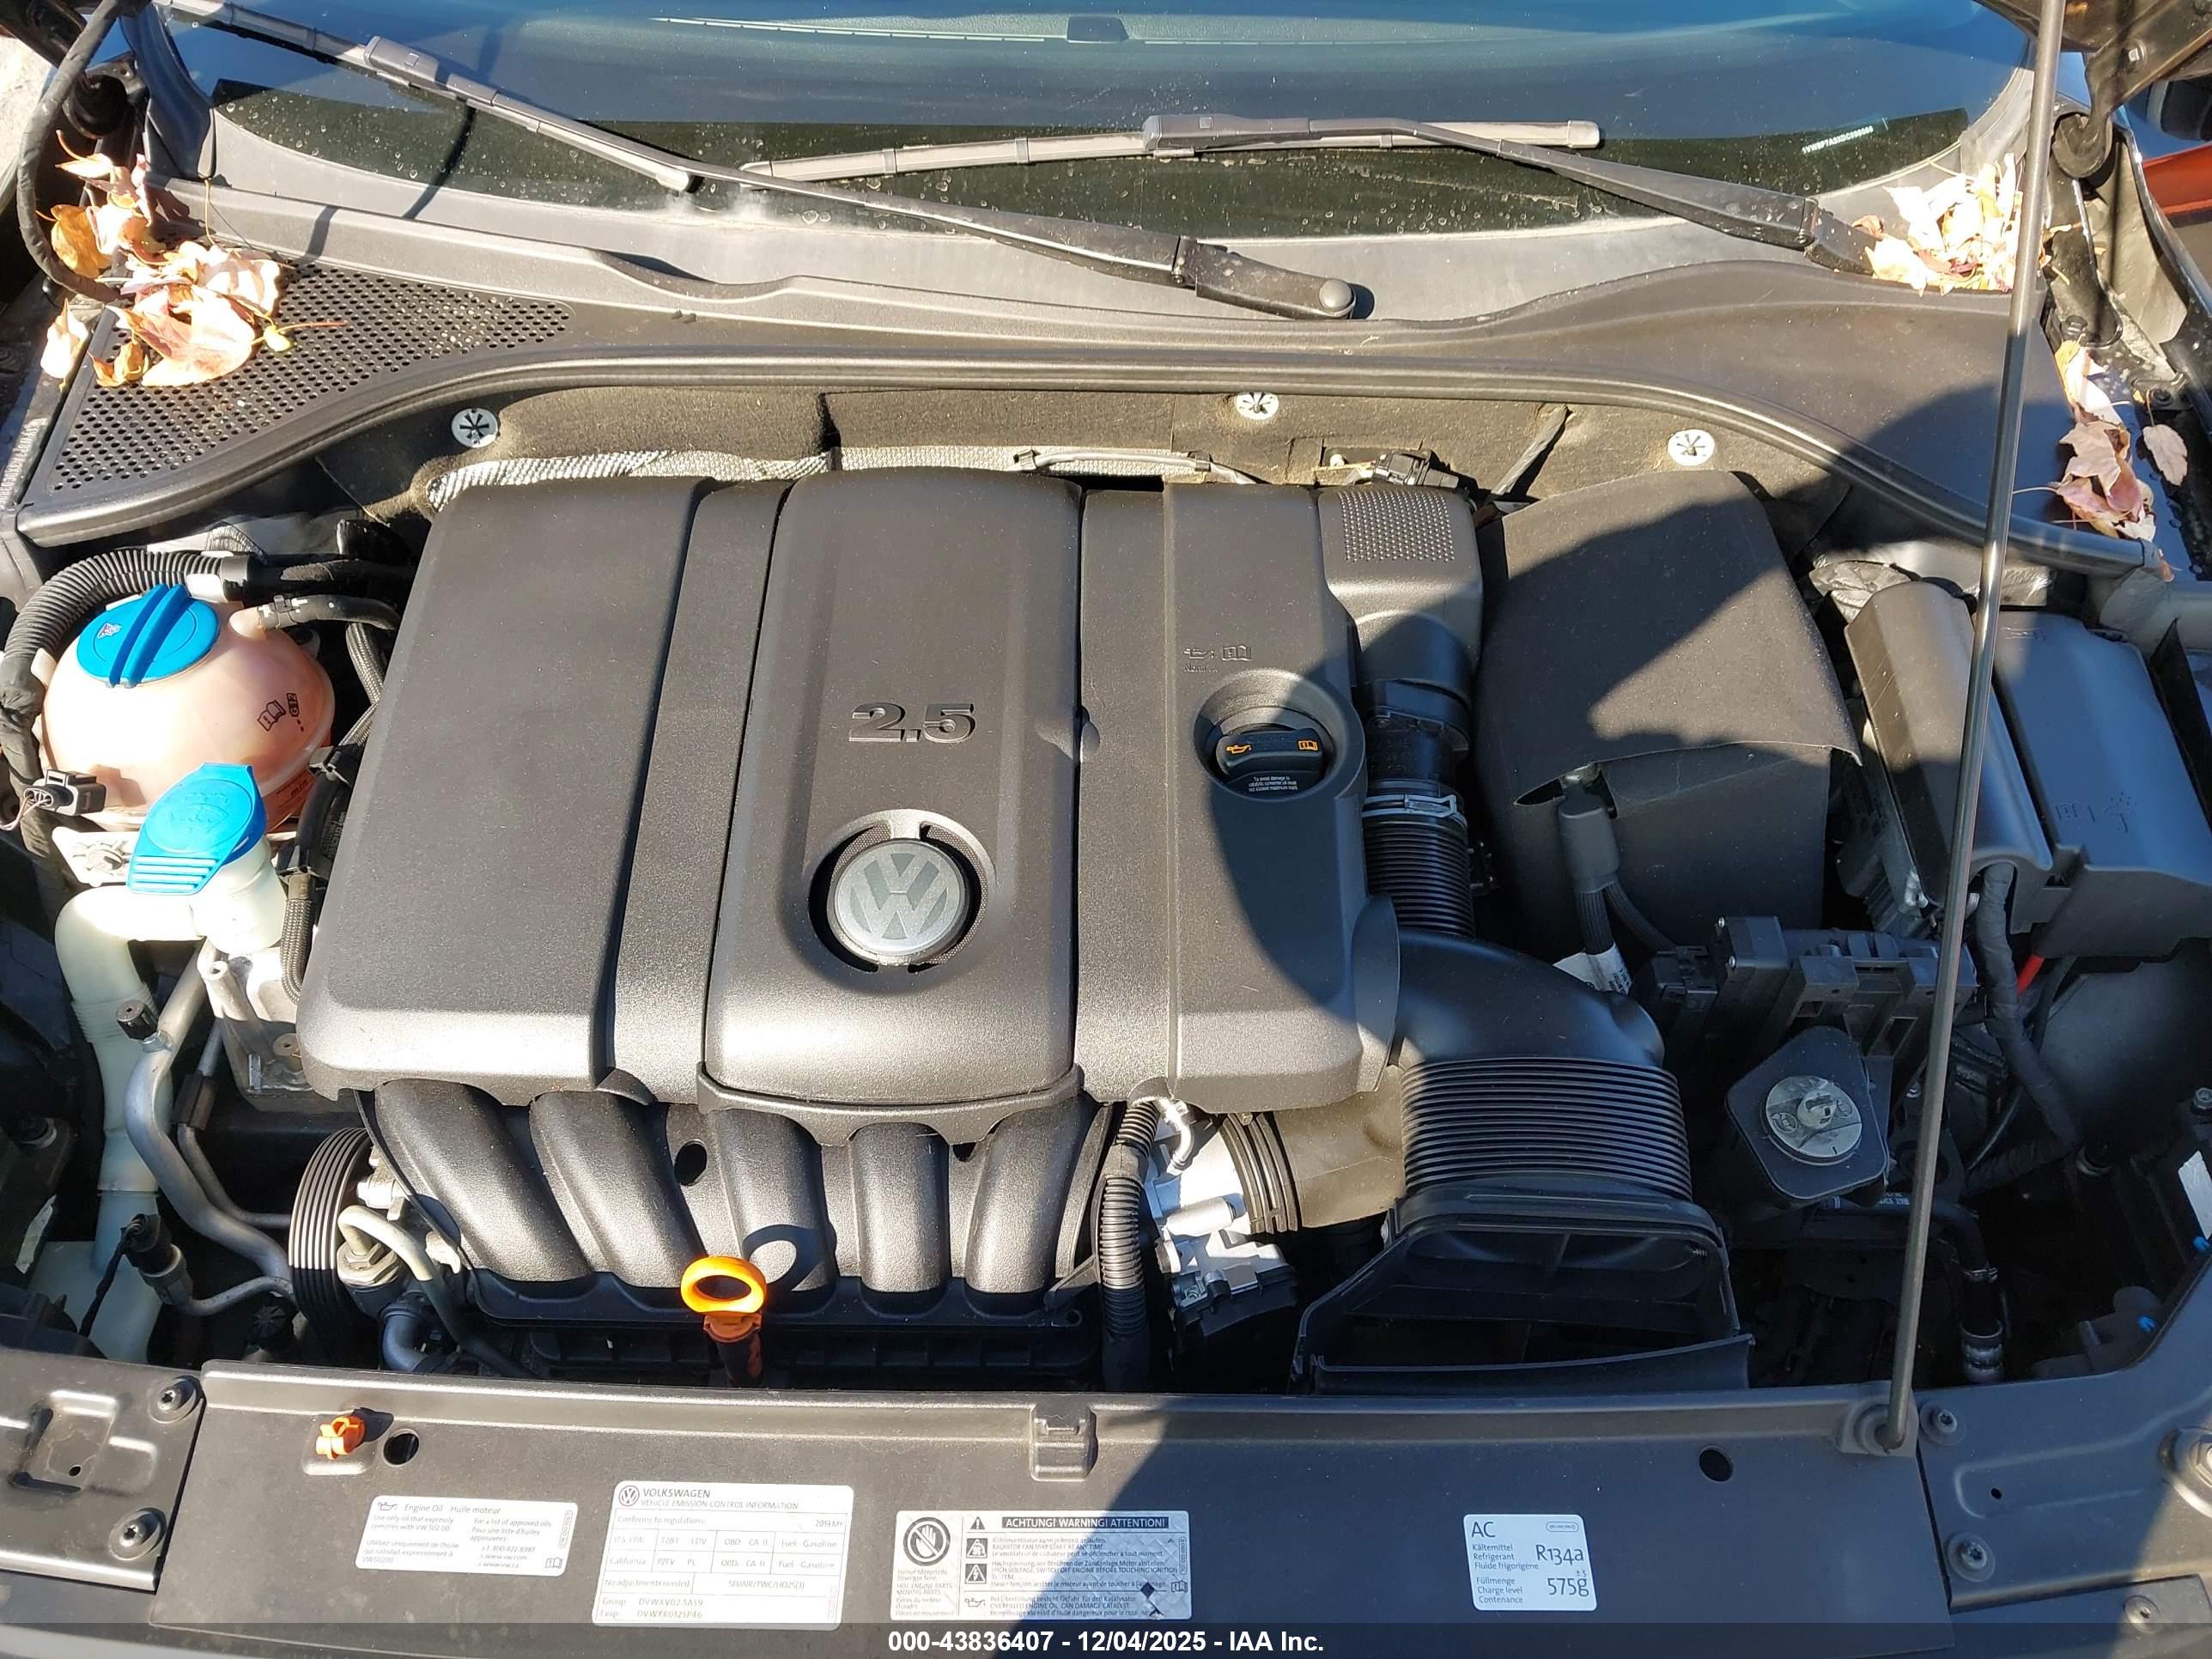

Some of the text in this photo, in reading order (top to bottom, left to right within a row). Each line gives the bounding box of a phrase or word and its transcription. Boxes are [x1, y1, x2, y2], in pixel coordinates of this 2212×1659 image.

[848, 702, 976, 744] 2.5
[643, 1488, 711, 1498] VOLKSWAGEN
[404, 1504, 430, 1514] Engine
[709, 1500, 743, 1509] CONTROL
[386, 1514, 400, 1522] only
[1006, 1518, 1165, 1528] ACHTUNG! WARNING! ATTENTION!
[1472, 1522, 1496, 1538] AC
[803, 1540, 837, 1548] Gasoline
[1473, 1553, 1515, 1562] Refrigerant
[1535, 1544, 1584, 1565] R134a
[800, 1560, 836, 1570] Gasoline
[1476, 1577, 1589, 1597] Füllmenge 575g
[1477, 1586, 1523, 1595] Charge level
[1479, 1595, 1523, 1604] Contenance
